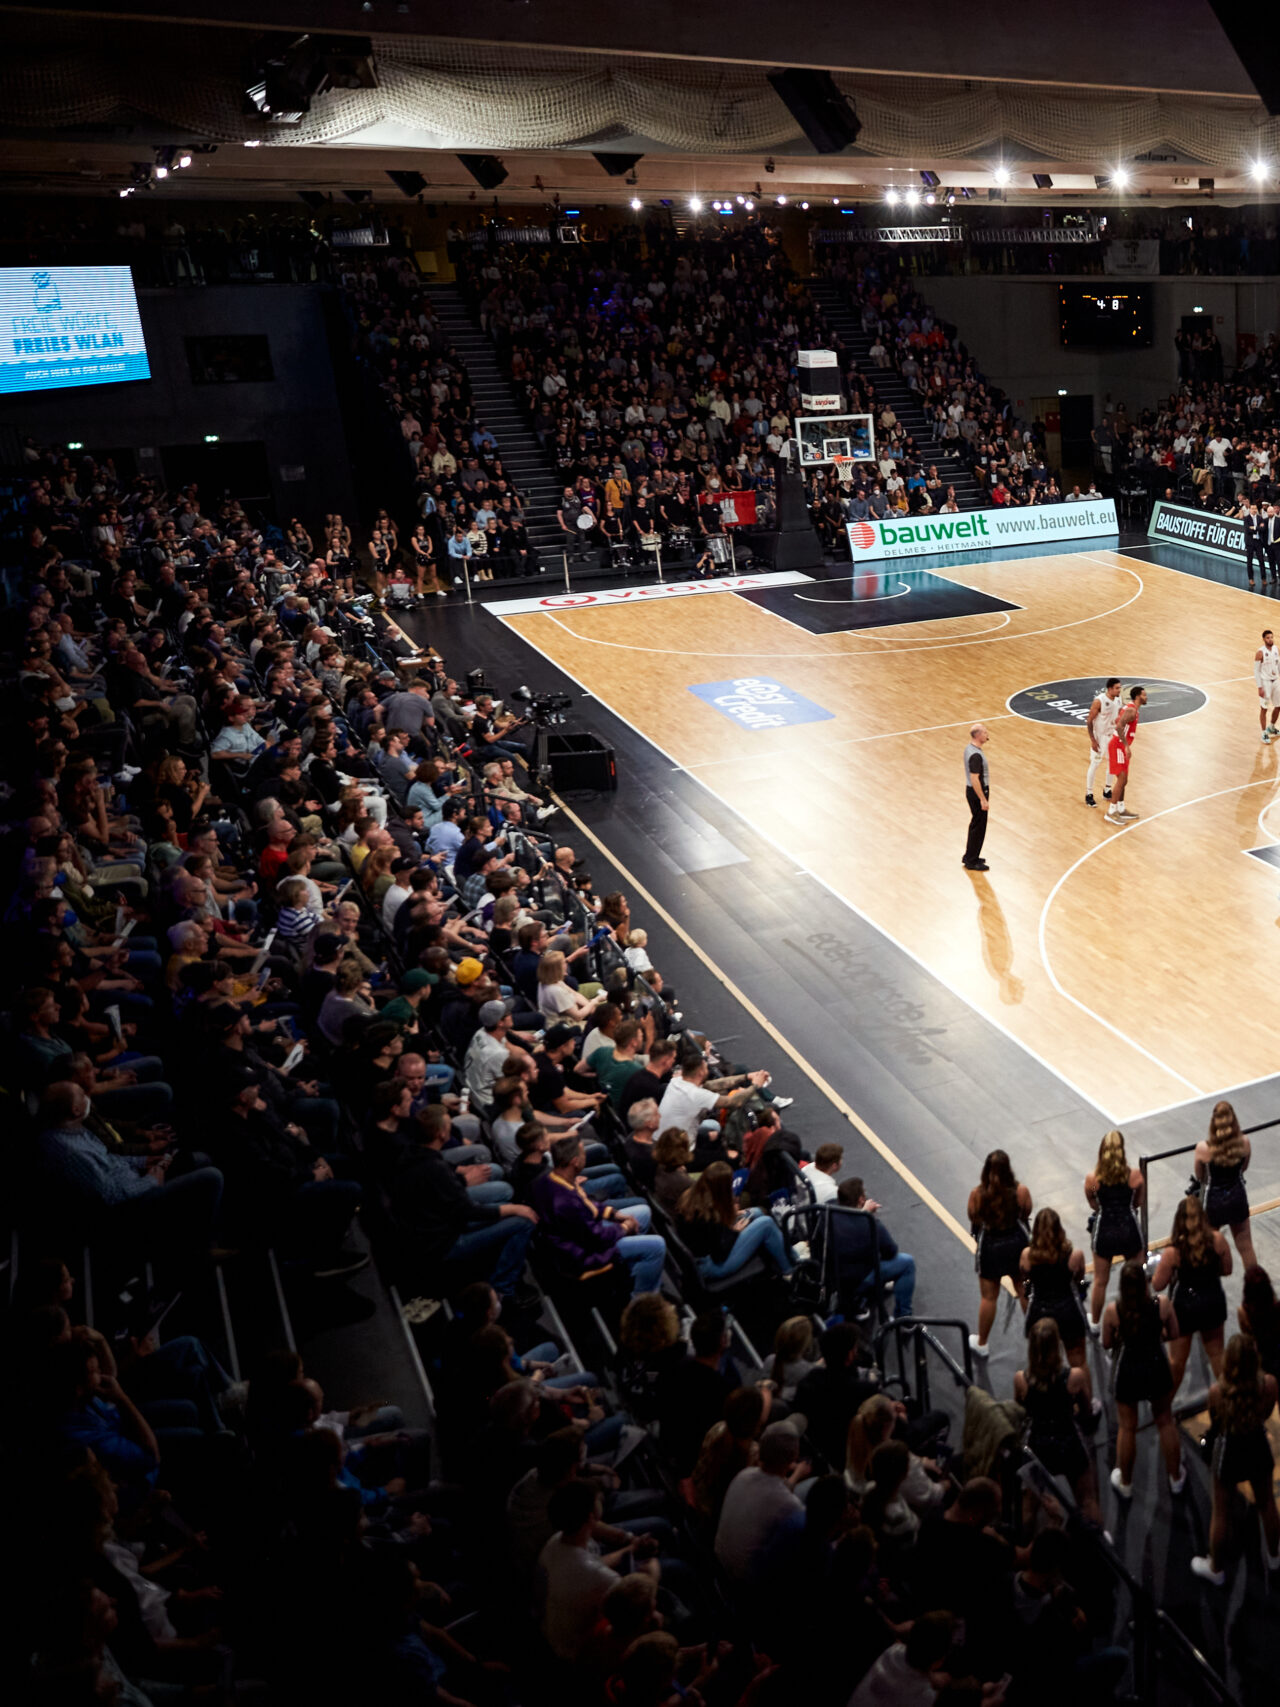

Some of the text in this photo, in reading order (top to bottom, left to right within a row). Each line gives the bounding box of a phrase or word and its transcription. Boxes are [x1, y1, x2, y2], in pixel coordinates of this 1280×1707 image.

[12, 315, 56, 334] FREIE
[13, 331, 125, 355] FREIES WLAN
[879, 510, 1116, 546] bauwelt www.bauwelt.eu
[1156, 512, 1207, 540] BAUSTOFFE
[1206, 523, 1227, 545] FÜR
[884, 539, 992, 556] DELMES HEITMANN
[608, 579, 764, 598] VEOLIA
[1046, 699, 1090, 723] BLAC
